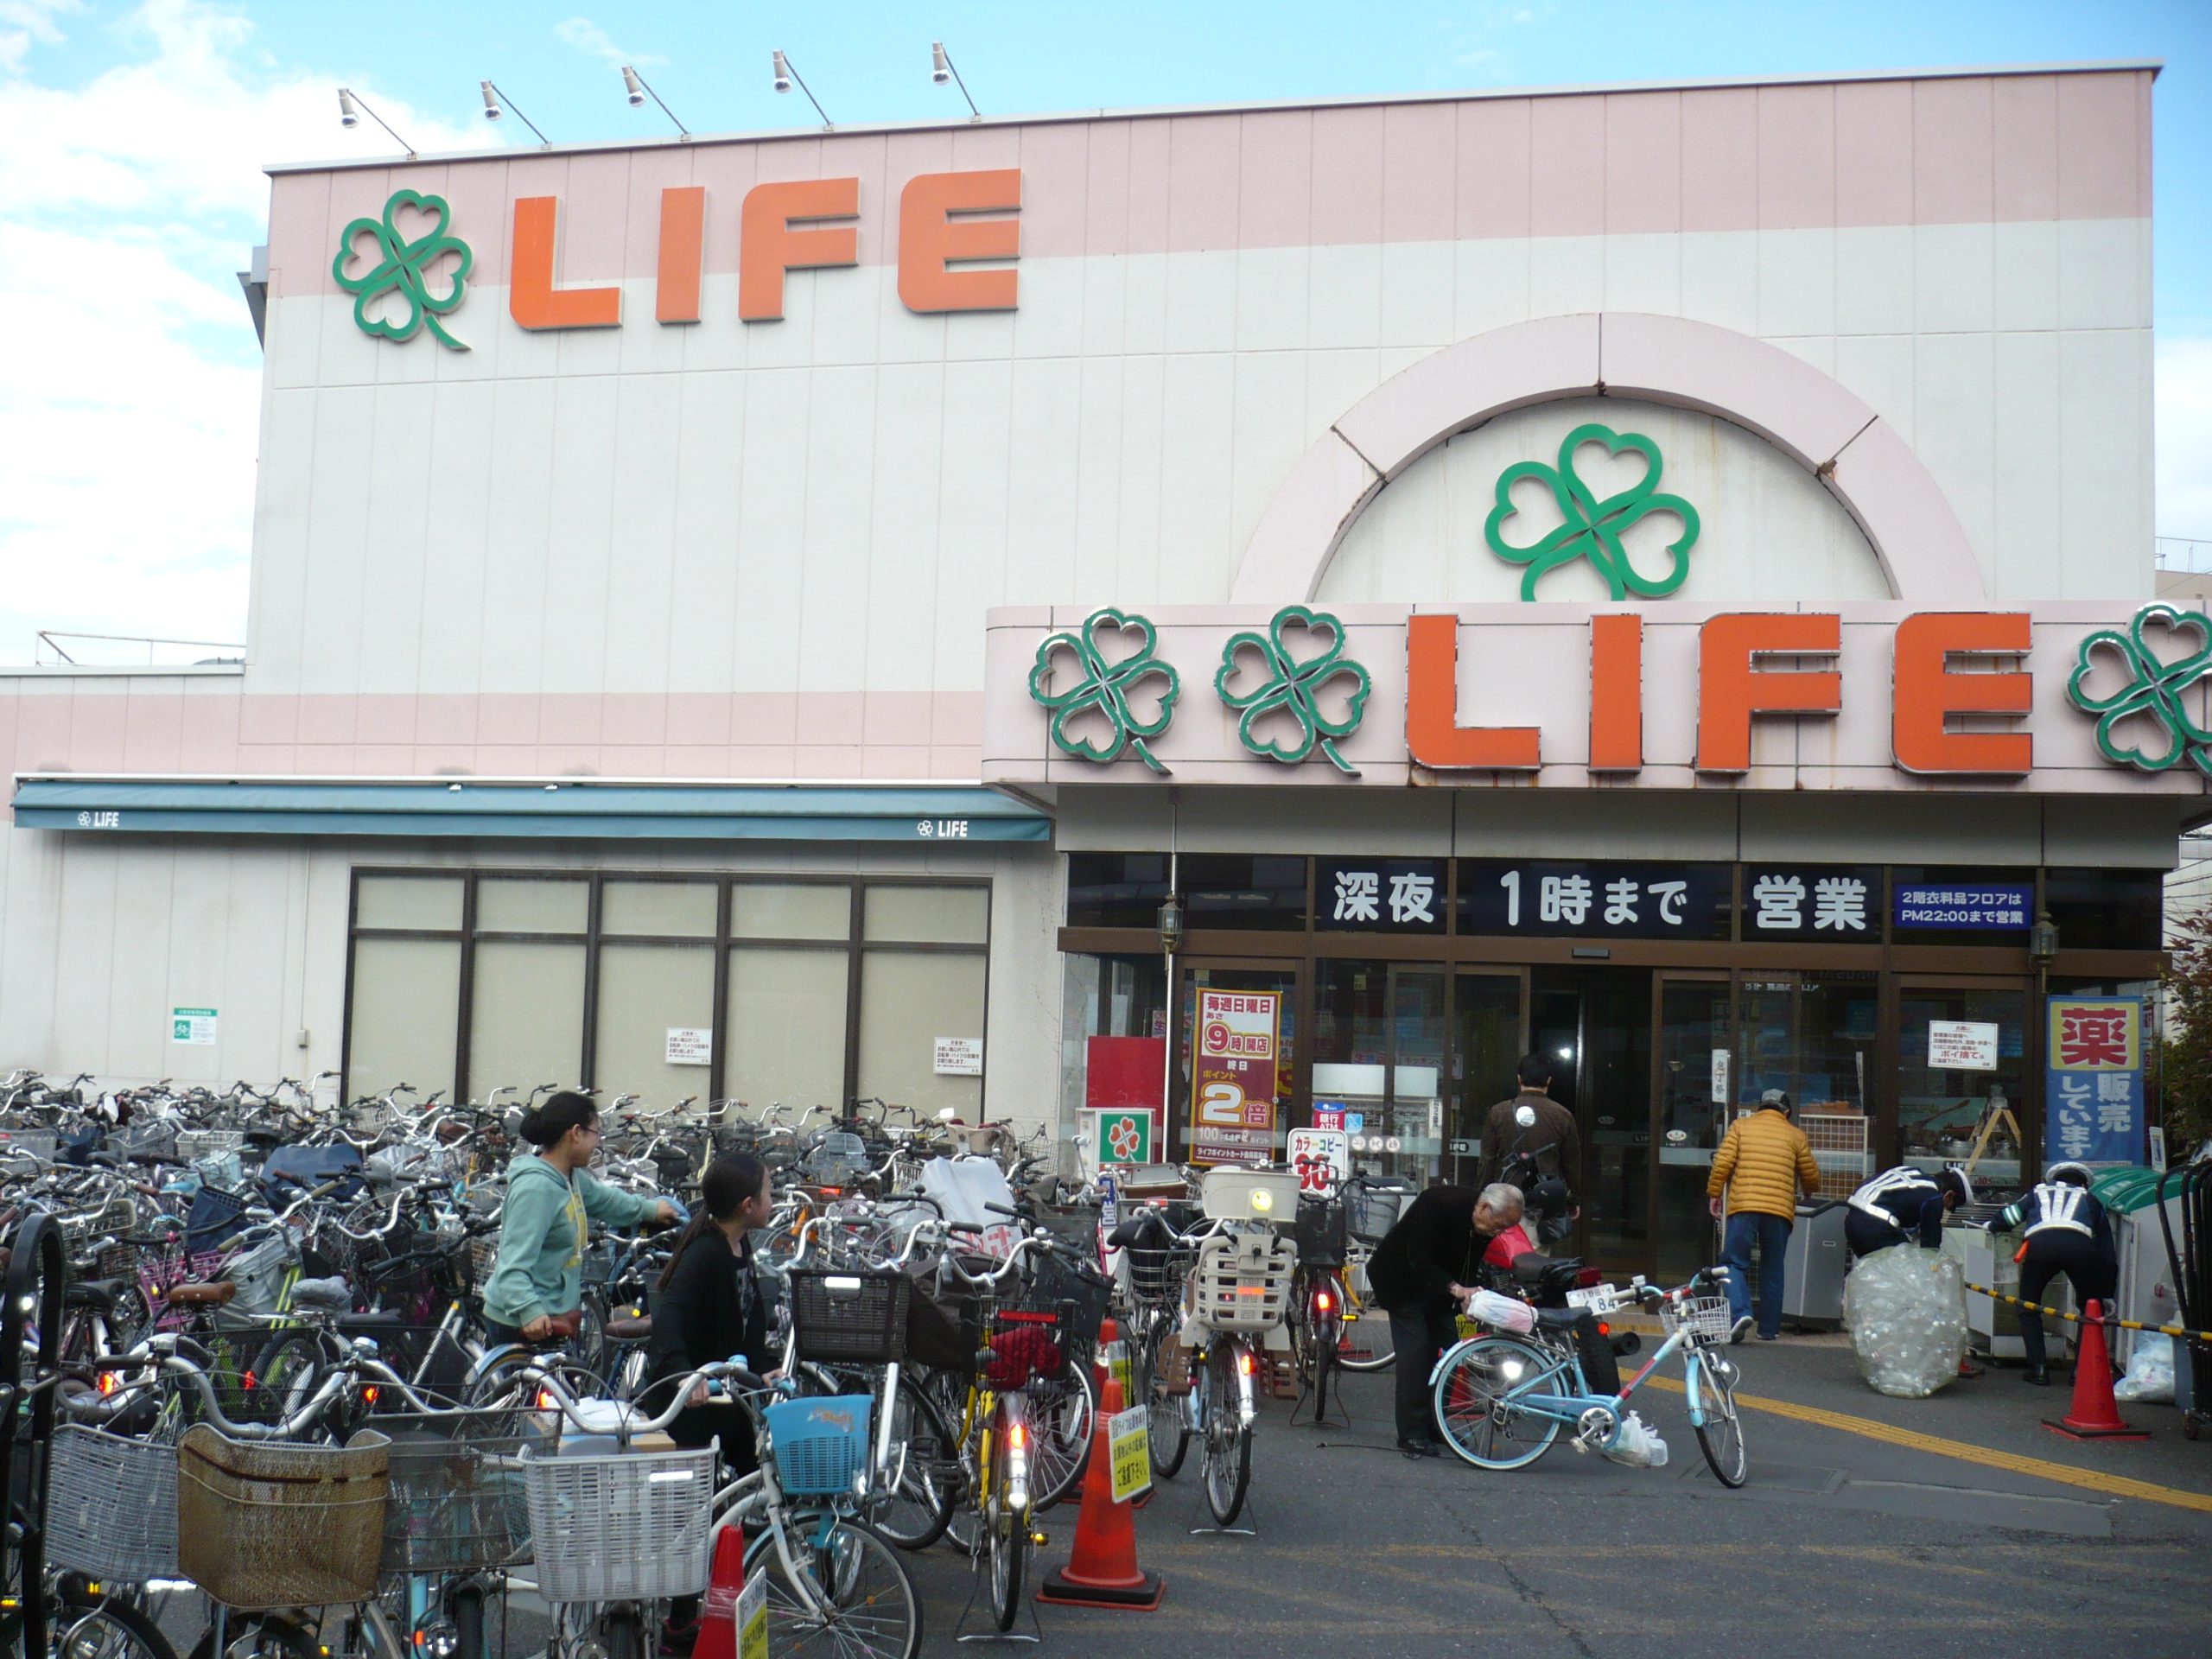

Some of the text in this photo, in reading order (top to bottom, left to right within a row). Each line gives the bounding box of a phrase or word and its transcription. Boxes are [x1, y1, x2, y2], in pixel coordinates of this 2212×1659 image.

[509, 168, 1021, 331] LIFE
[1405, 612, 2033, 776] LIFE
[94, 811, 119, 827] LIFE
[938, 820, 968, 837] LIFE
[1333, 869, 1867, 931] 深夜 1時まで 営業
[1902, 891, 2022, 905] 2階衣料品フロアは
[1901, 910, 2024, 924] PM22:00まで営業
[1207, 996, 1270, 1014] 毎週日曜日
[2060, 1007, 2127, 1065] 薬
[1203, 1070, 1236, 1080] ポイント
[1202, 1084, 1268, 1124] 2倍
[2097, 1073, 2131, 1133] 販売
[1319, 1114, 1339, 1123] 銀行
[2058, 1076, 2092, 1160] しています
[1295, 1136, 1343, 1153] カラーコピー
